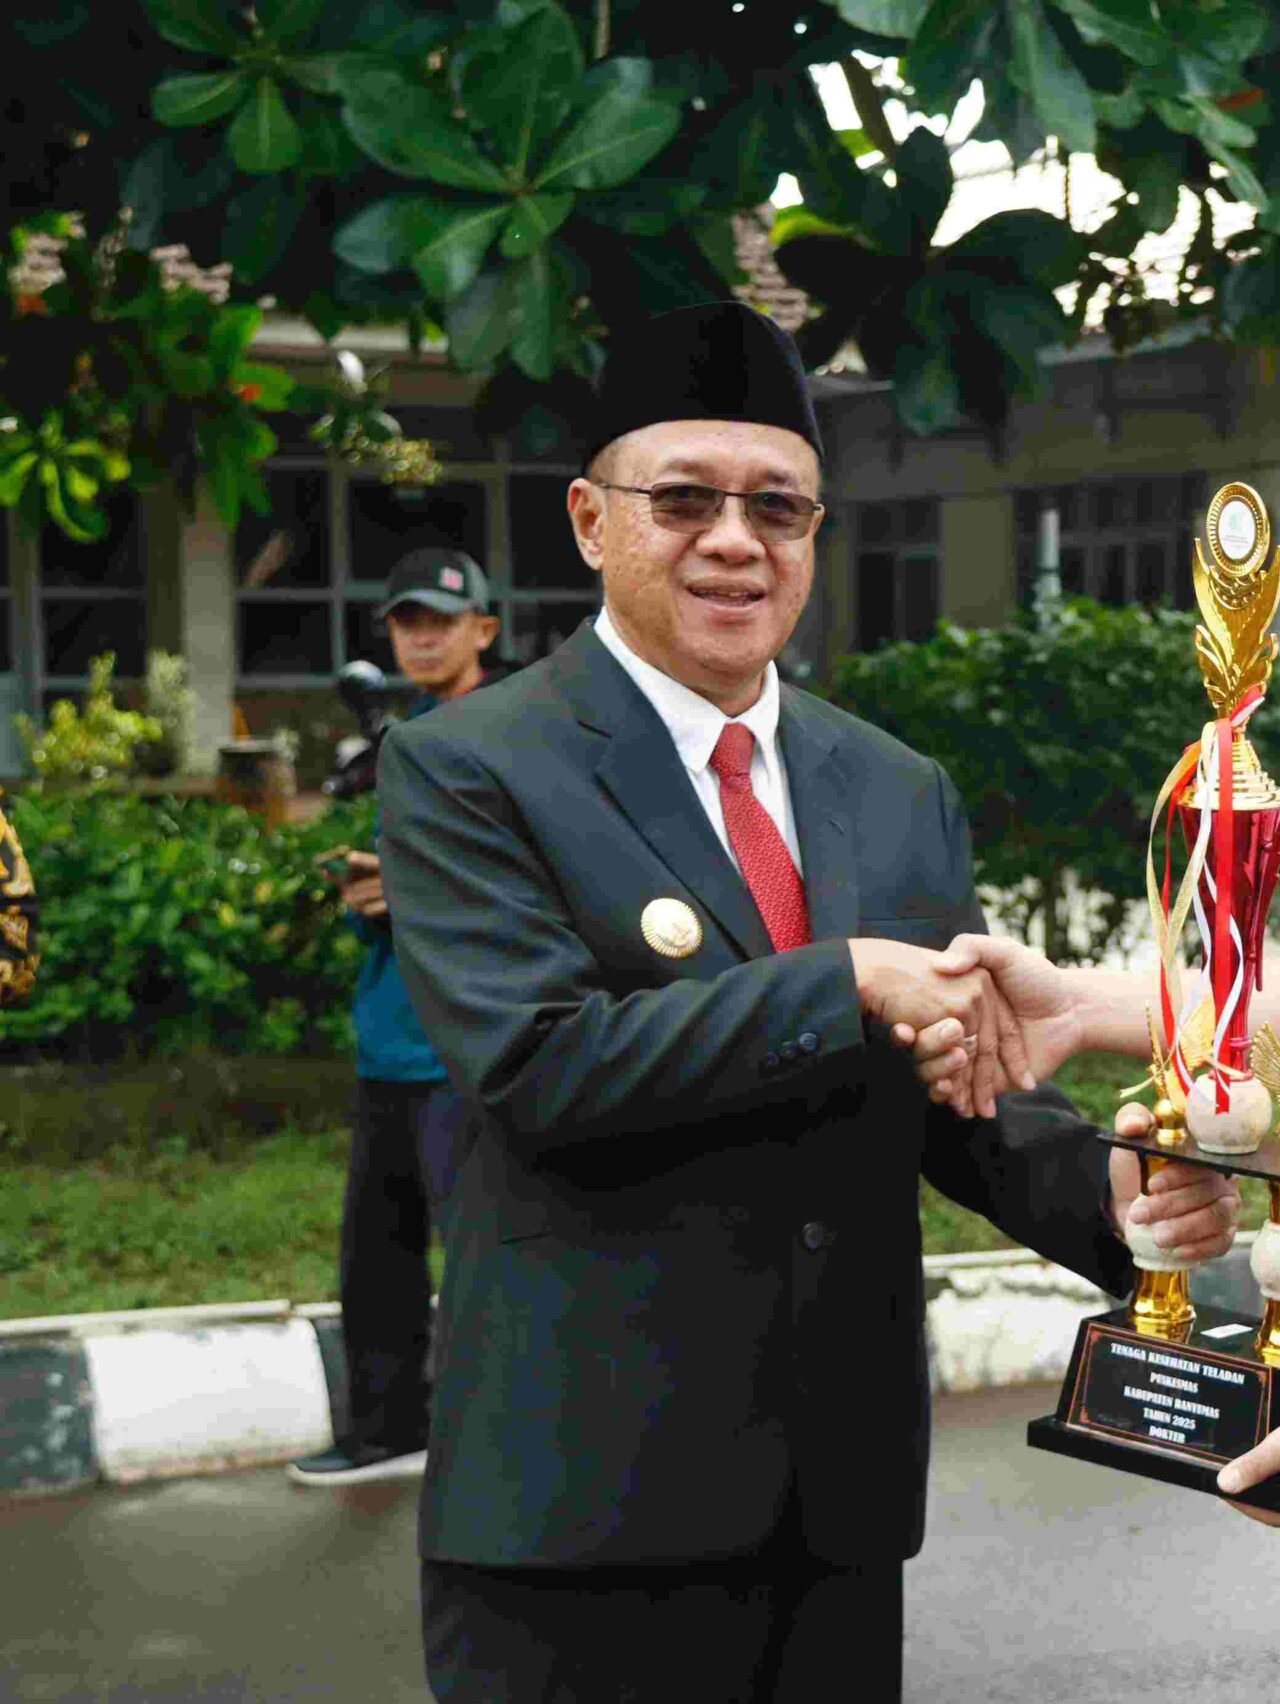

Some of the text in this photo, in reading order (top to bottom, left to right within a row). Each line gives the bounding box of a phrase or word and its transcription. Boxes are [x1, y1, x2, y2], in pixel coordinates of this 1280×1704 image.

[1110, 1342, 1245, 1385] TENAGA KESEHATAN TELADAN
[1149, 1371, 1199, 1393] PUSKESMAS
[1123, 1385, 1220, 1419] KABUPATEN BANYUMAS
[1143, 1407, 1196, 1430] TAHUN 2025
[1149, 1425, 1186, 1444] DOKTER
